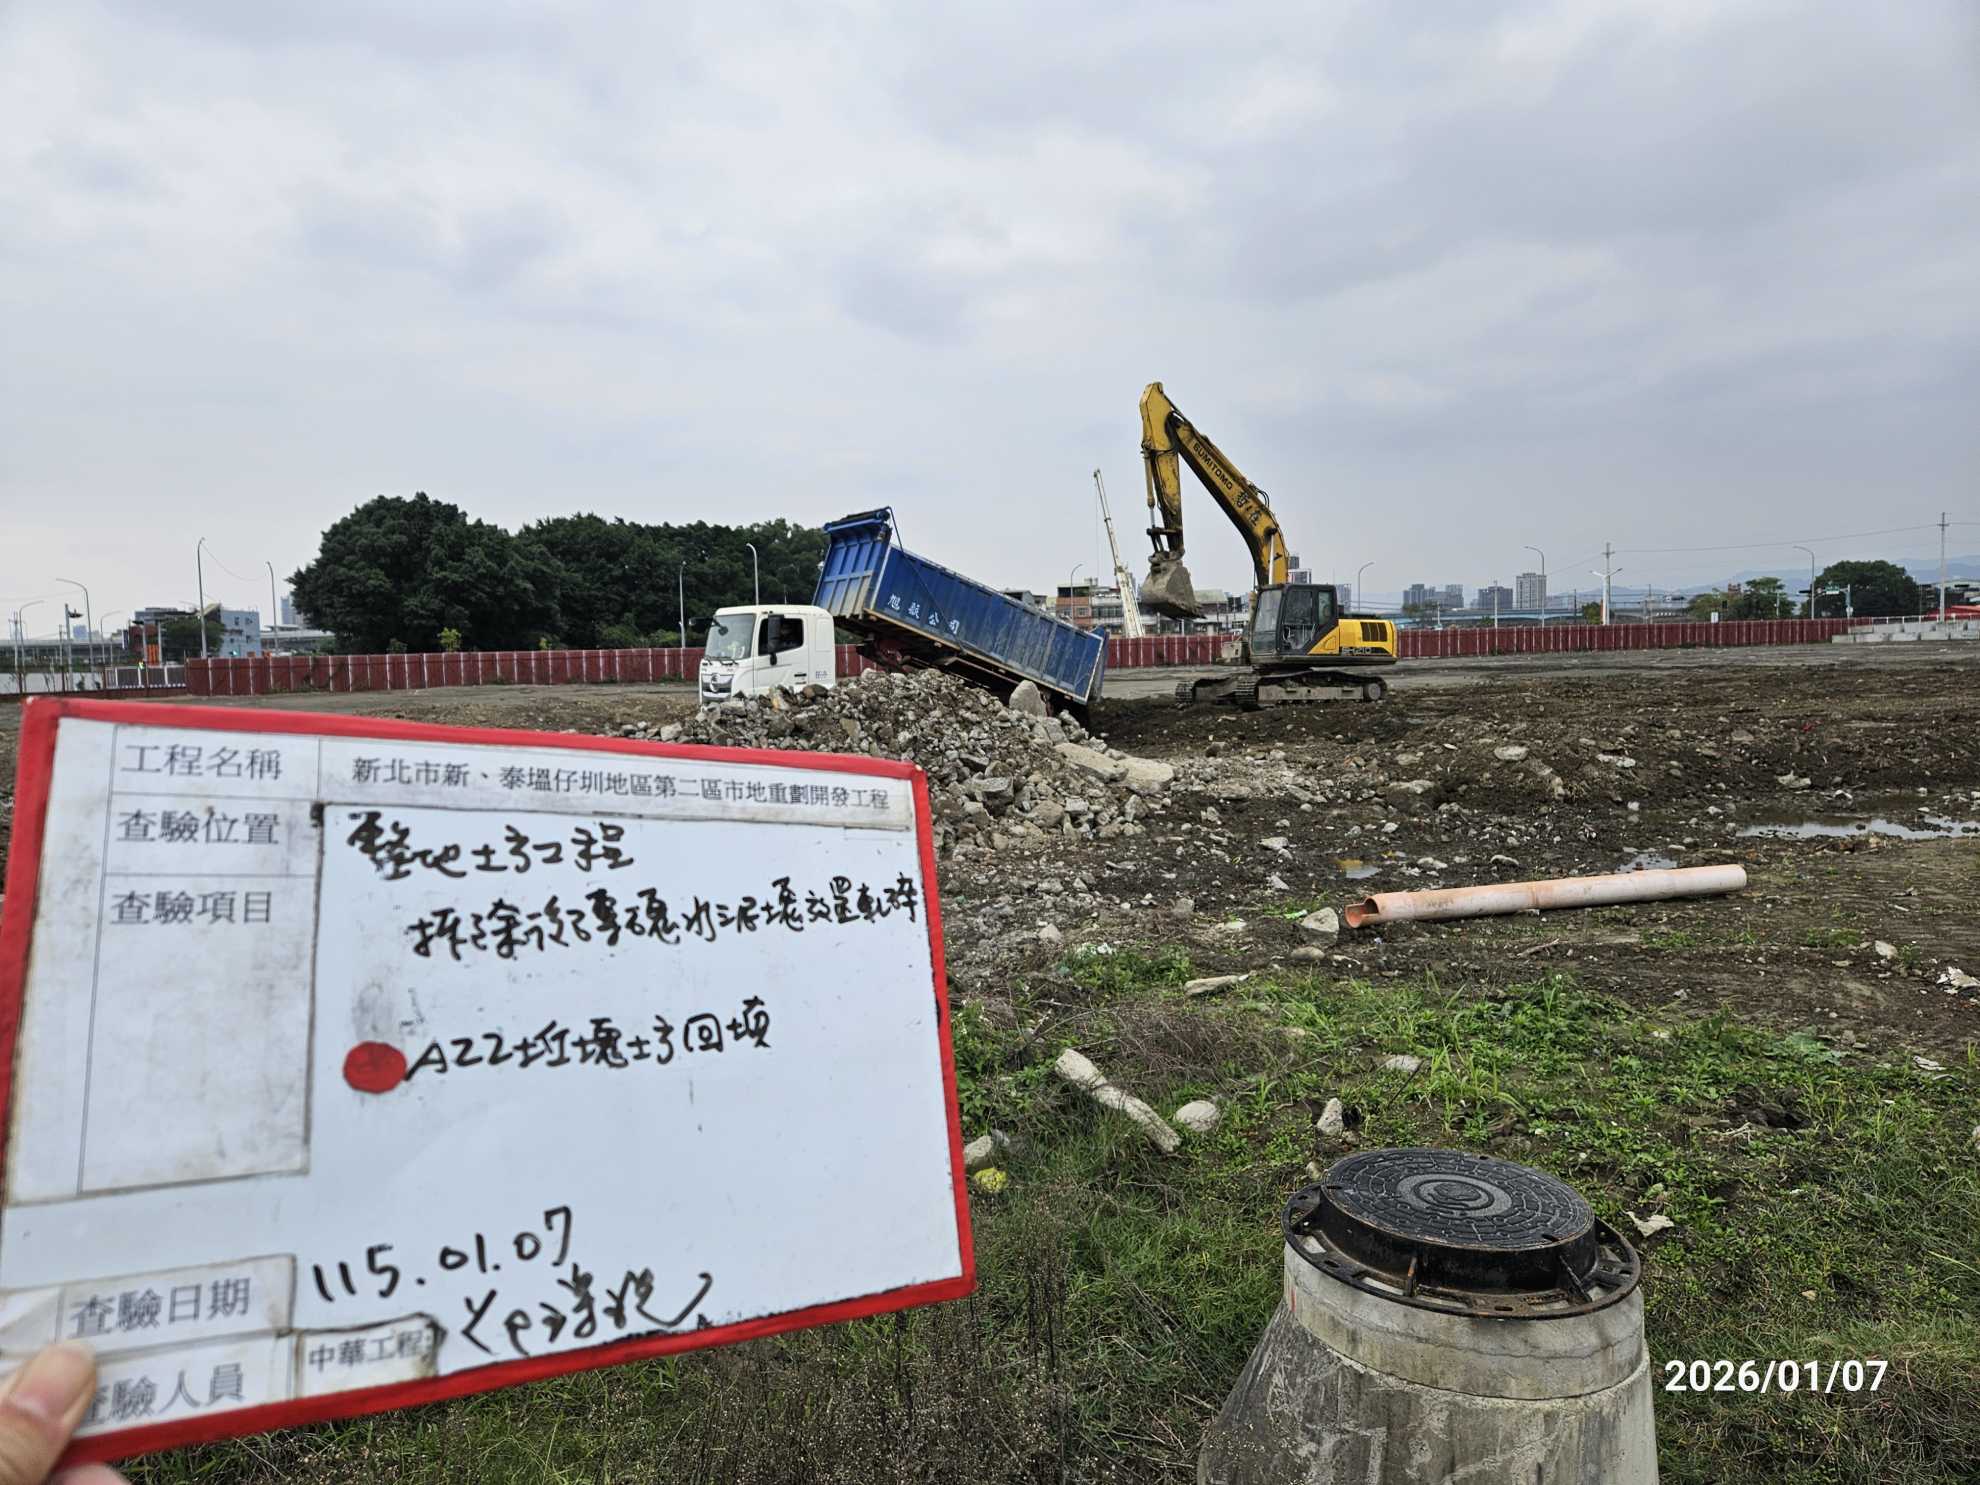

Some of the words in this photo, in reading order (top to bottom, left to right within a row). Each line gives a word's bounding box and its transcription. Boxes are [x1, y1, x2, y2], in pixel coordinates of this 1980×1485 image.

[120, 744, 283, 781] 工程名稱
[116, 809, 280, 845] 查驗位置
[110, 890, 272, 925] 查驗項目
[303, 1205, 572, 1302] 115.01.07
[68, 1277, 251, 1339] 查驗日期
